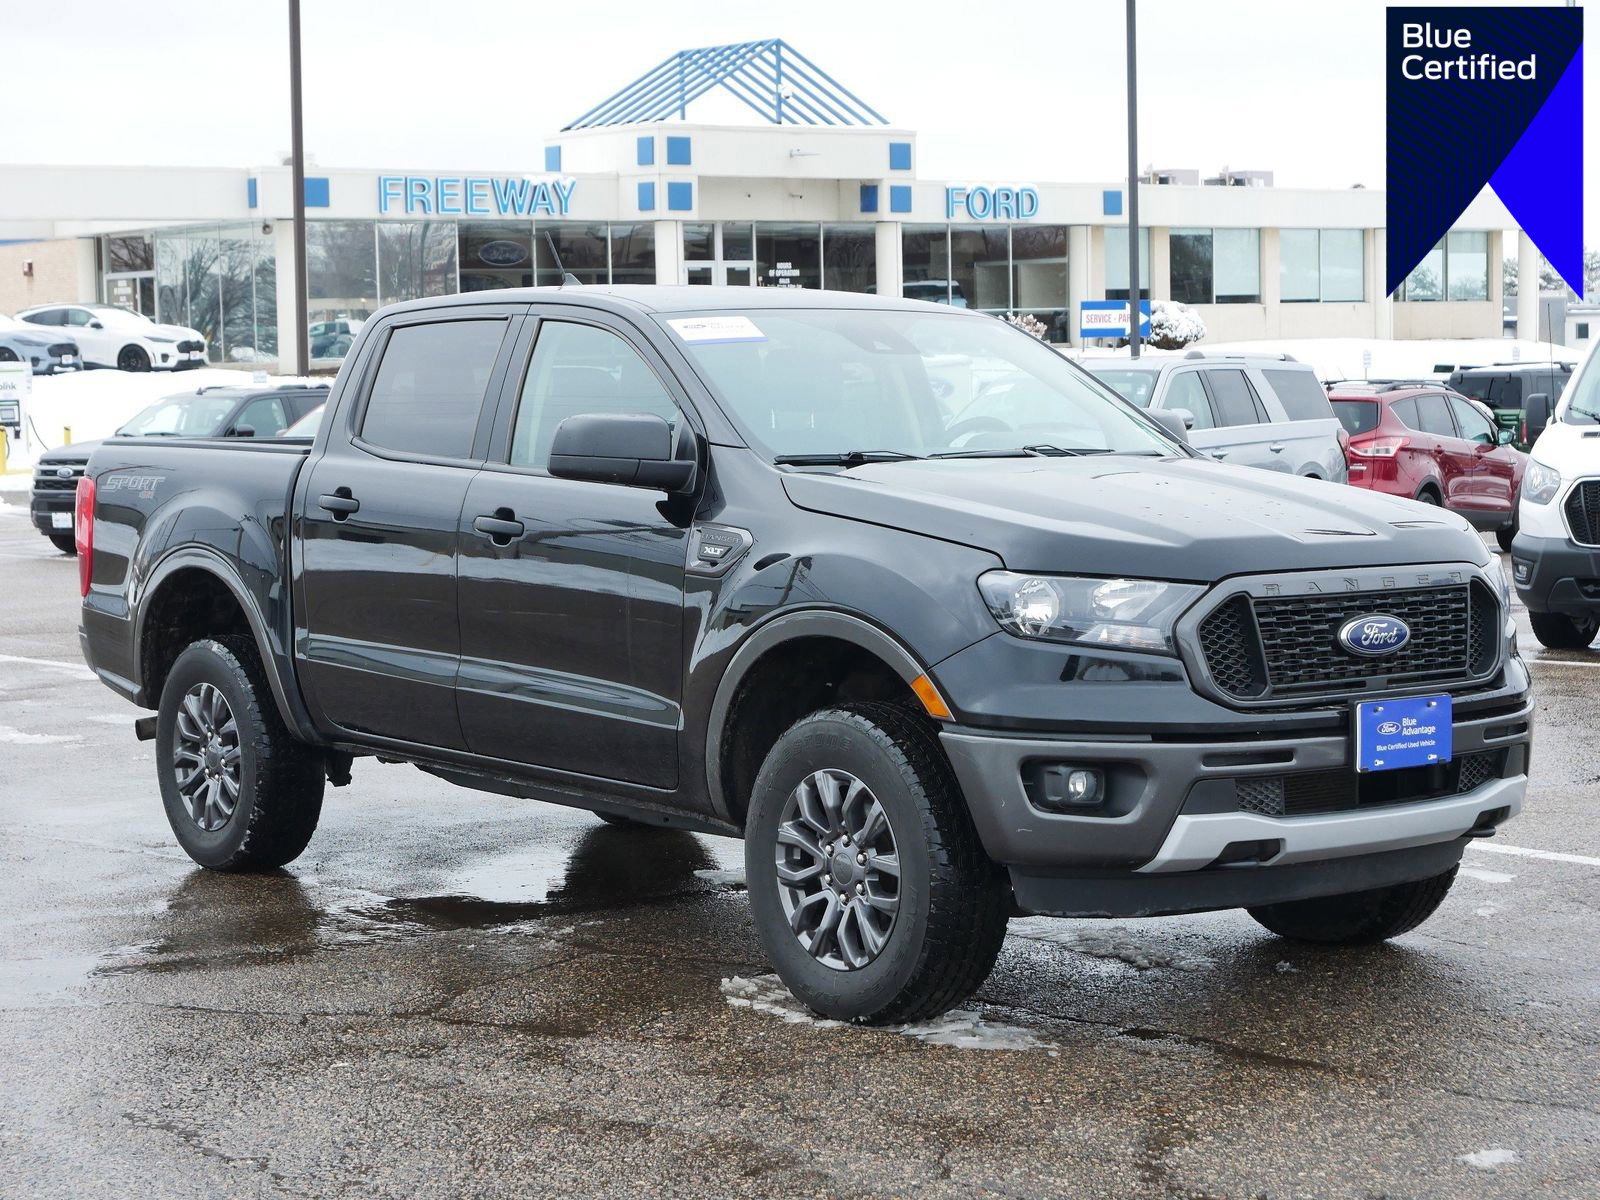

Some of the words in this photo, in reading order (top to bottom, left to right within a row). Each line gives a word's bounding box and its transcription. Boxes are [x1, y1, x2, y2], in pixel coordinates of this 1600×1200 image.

[378, 175, 577, 216] FREEWAY
[945, 183, 1039, 220] FORD
[1085, 313, 1112, 324] SERVICE
[100, 474, 166, 493] SPORT
[703, 546, 724, 555] XLT
[1262, 571, 1462, 595] RANGER
[1361, 622, 1398, 645] Ford
[1380, 723, 1397, 733] Ford
[1402, 717, 1417, 727] Blue
[1402, 725, 1436, 736] Advantage
[1387, 743, 1408, 751] Certified
[1407, 741, 1419, 749] Used
[1419, 739, 1436, 747] Vehicle
